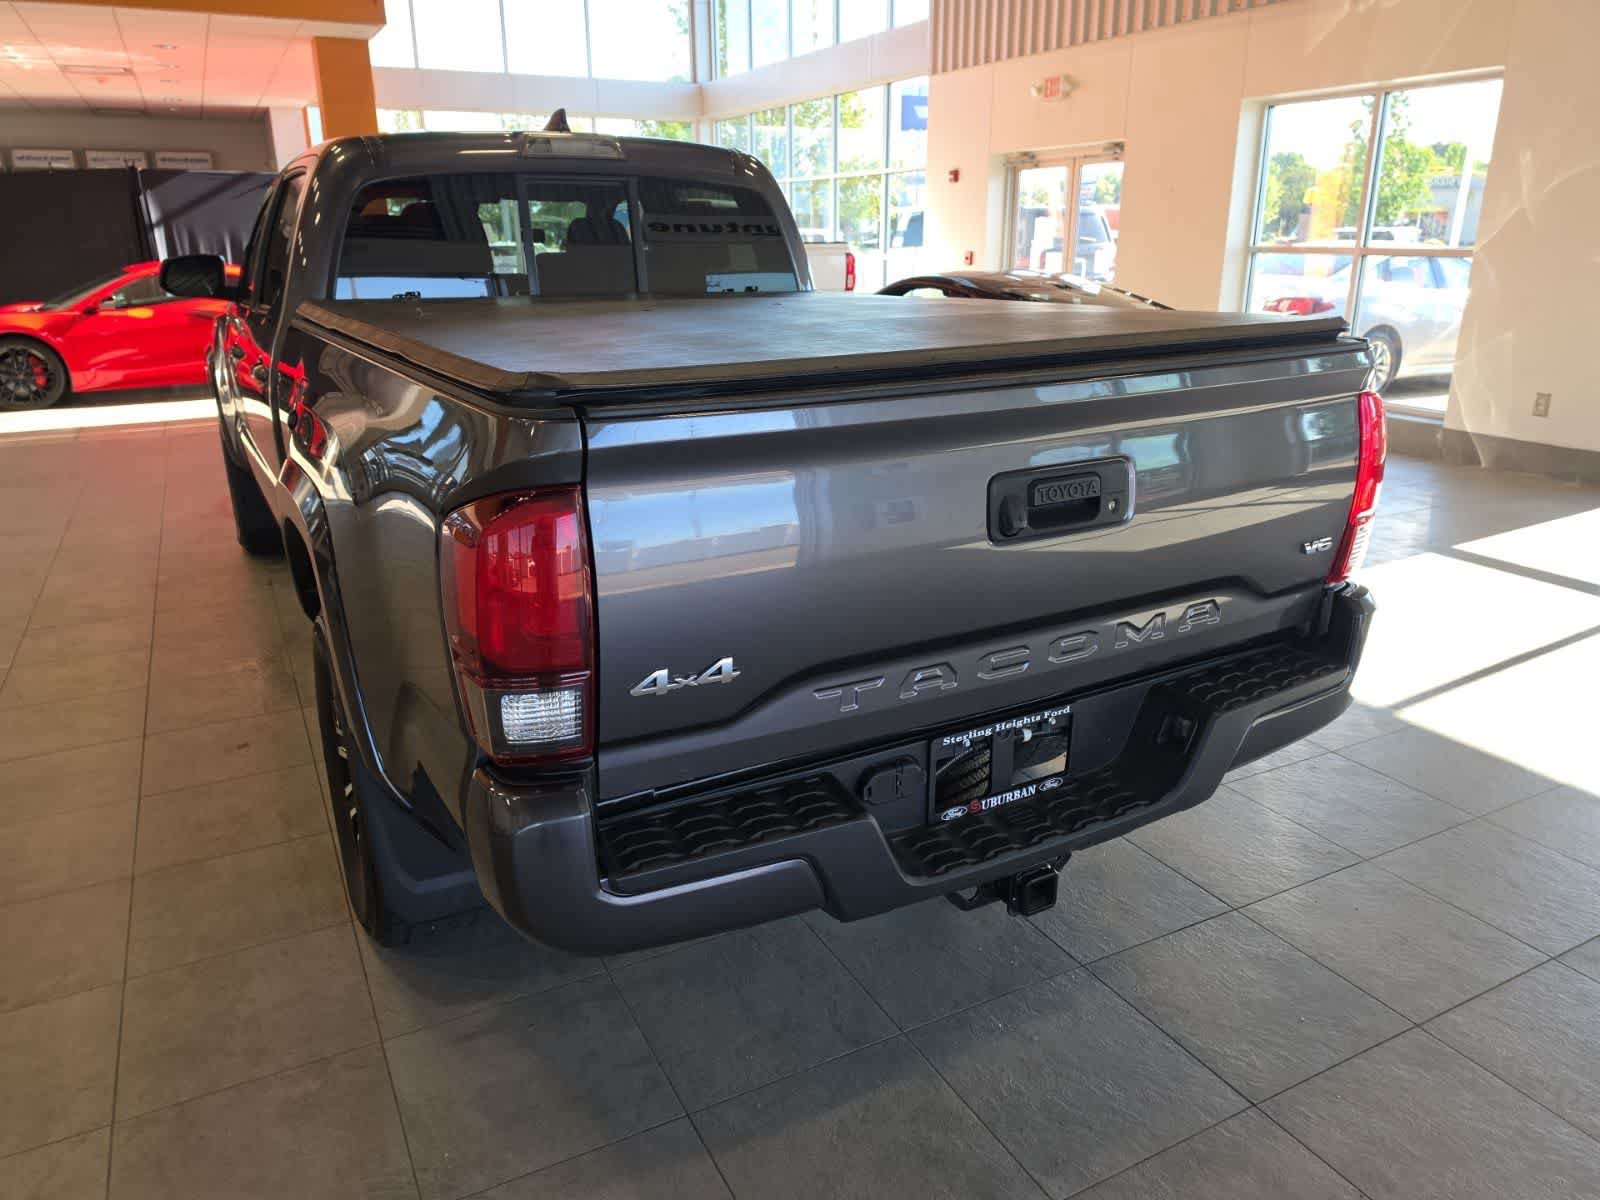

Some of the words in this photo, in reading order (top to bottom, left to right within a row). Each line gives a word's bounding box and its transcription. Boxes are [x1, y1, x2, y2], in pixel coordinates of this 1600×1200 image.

[1037, 480, 1098, 504] TOYOTA
[1304, 537, 1332, 555] V6
[812, 598, 1221, 712] TACOMA
[942, 727, 992, 746] Sterling
[995, 715, 1041, 732] Heights
[1043, 705, 1071, 719] Ford
[968, 784, 1037, 814] SUBURBAN
